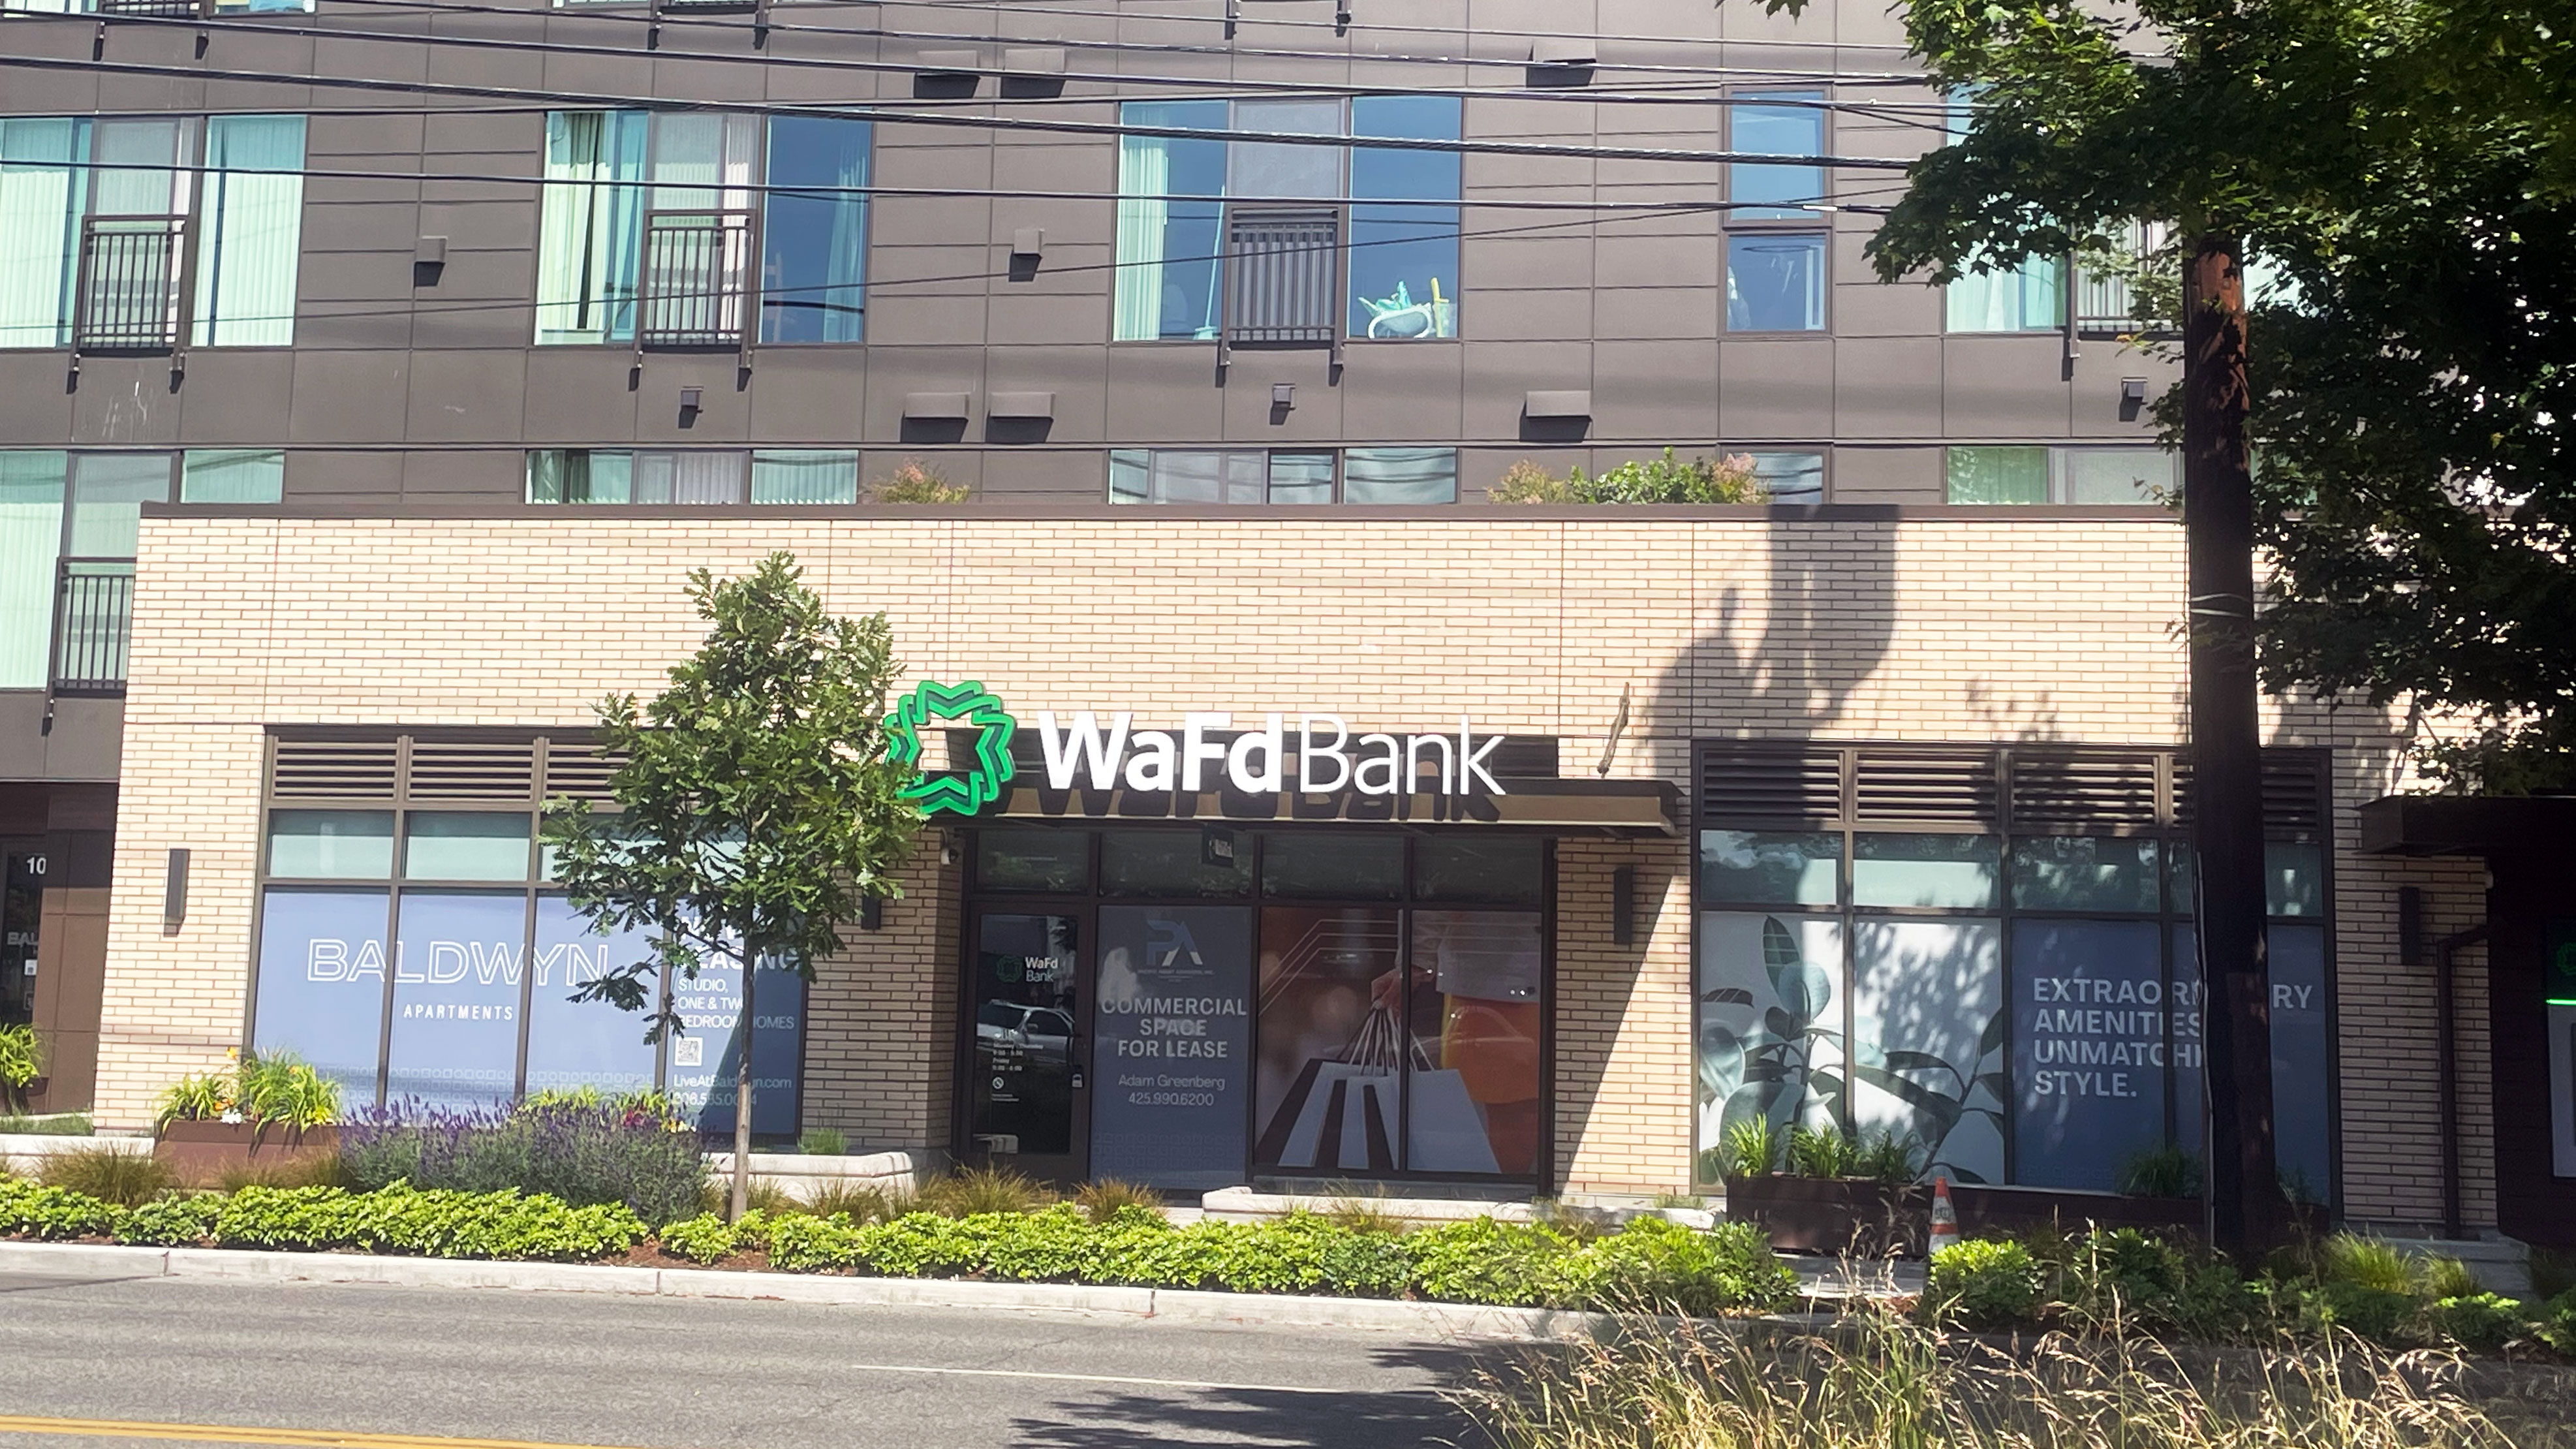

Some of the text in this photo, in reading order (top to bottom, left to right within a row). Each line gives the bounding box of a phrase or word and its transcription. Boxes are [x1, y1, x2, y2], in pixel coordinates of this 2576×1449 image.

[1036, 710, 1508, 795] WaFd Bank
[307, 939, 609, 986] BALDWYN
[1025, 956, 1058, 969] WaFd
[1026, 969, 1054, 982] Bank
[677, 978, 729, 993] STUDIO,
[403, 1003, 514, 1021] APARTMENTS
[677, 996, 743, 1010] ONE & TW
[1101, 997, 1247, 1016] COMMERCIAL
[1140, 1018, 1207, 1036] SPACE
[2034, 1008, 2200, 1037] AMENITIES
[1118, 1040, 1228, 1059] FOR LEASE
[1119, 1074, 1226, 1091] Adam Greenberg
[2034, 1070, 2137, 1097] STYLE.
[1128, 1092, 1215, 1106] 425.990.6200
